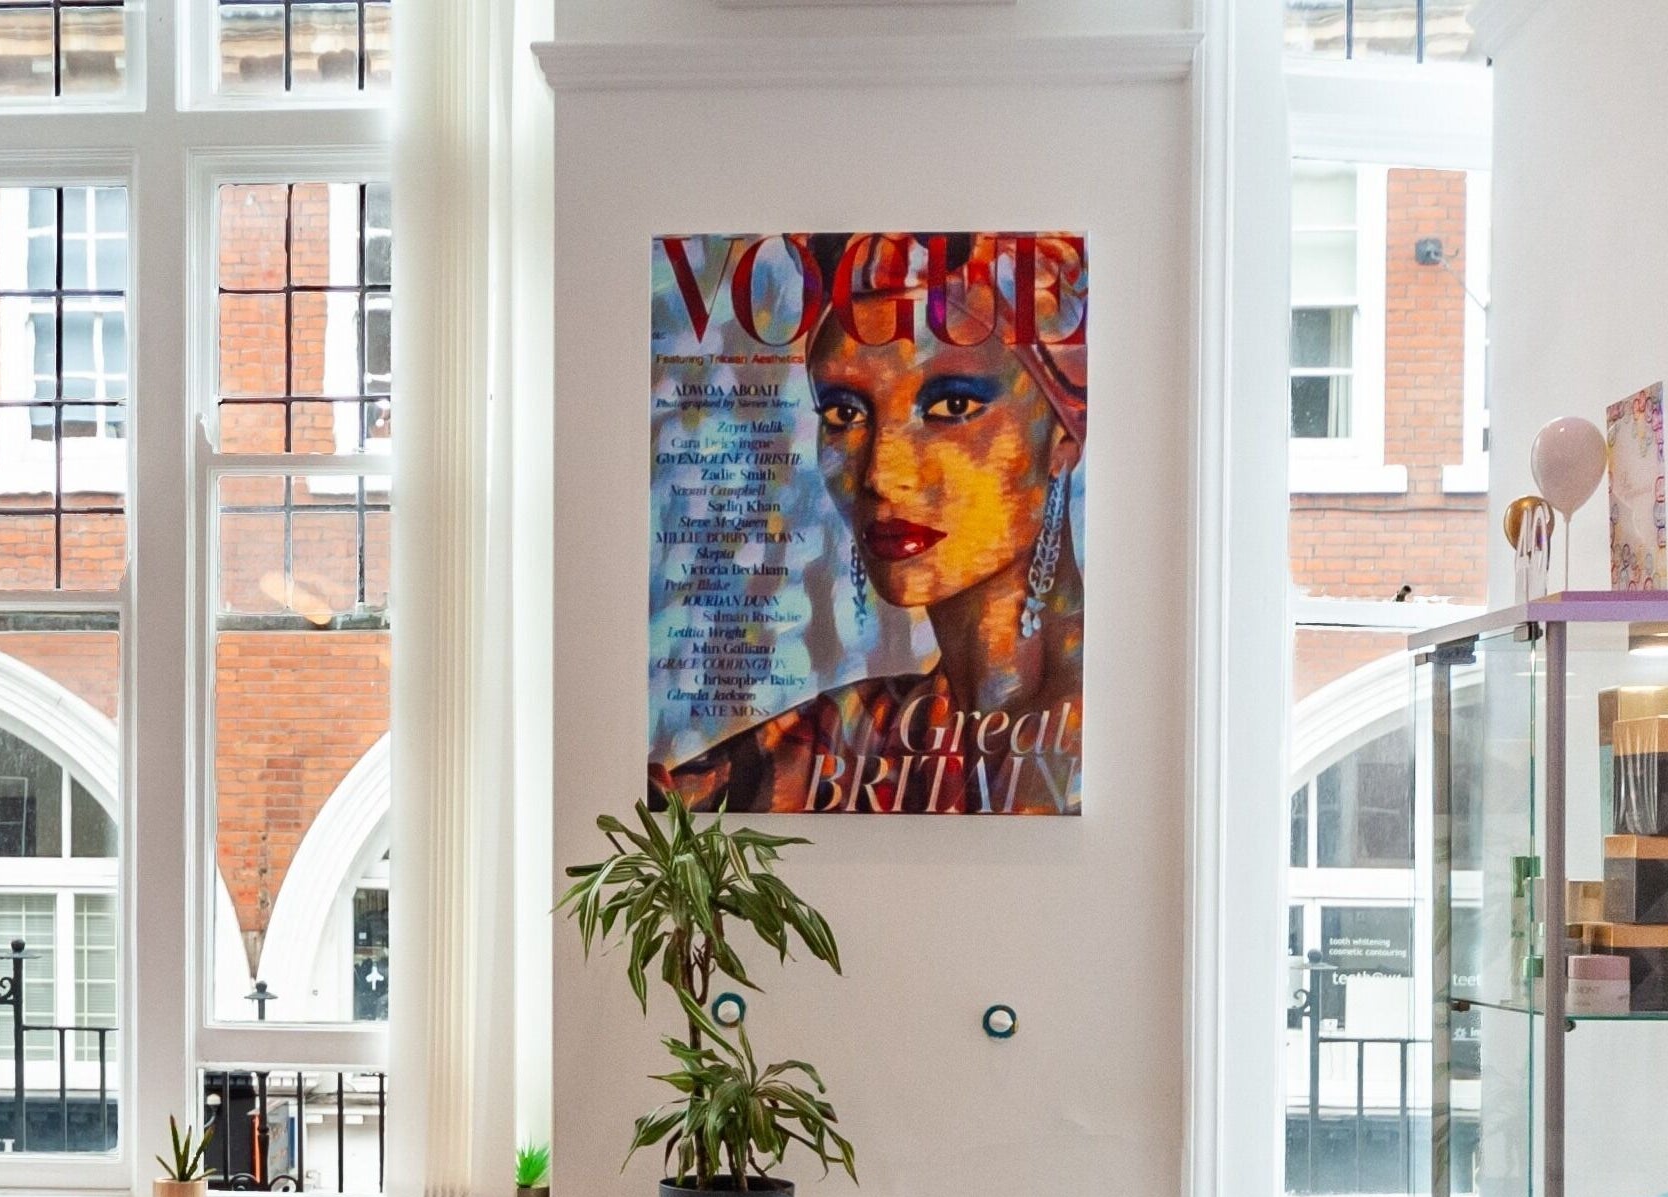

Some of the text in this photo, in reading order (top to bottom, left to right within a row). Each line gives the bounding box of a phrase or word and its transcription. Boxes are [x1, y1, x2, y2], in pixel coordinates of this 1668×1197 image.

[652, 236, 1088, 347] VOGUE
[656, 354, 704, 365] Featuring
[751, 354, 805, 364] Aesthetics
[673, 384, 779, 396] ADWOA ABOAH
[716, 420, 783, 434] Zayn Malik
[671, 437, 700, 449] Cara
[656, 453, 802, 465] GWENDOLINE CHRISTIE
[701, 468, 776, 480] Zadie Smith
[670, 484, 766, 498] Naomi Campbell
[707, 500, 780, 514] Sadiq Khan
[679, 517, 768, 531] Steve McQueen
[656, 532, 807, 544] MILLIE BOBBY BROWN
[695, 547, 735, 562] Skepta
[682, 563, 789, 576] Victoria Beckham
[664, 579, 731, 591] Peter Blake
[683, 595, 781, 606] JOURDAN DUNN
[703, 610, 802, 622] Salman Rushdie
[708, 627, 747, 640] Wright
[692, 641, 775, 654] John Galliano
[656, 657, 699, 669] GRACE
[694, 673, 807, 689] Christopher Bailey
[667, 689, 757, 701] Glenda Jackson
[689, 704, 770, 717] KATE MOSS
[899, 694, 1074, 755] Great
[803, 754, 1080, 813] BRITAIN
[1330, 937, 1390, 948] tooth whitening
[1328, 947, 1407, 958] cosmetic contouring
